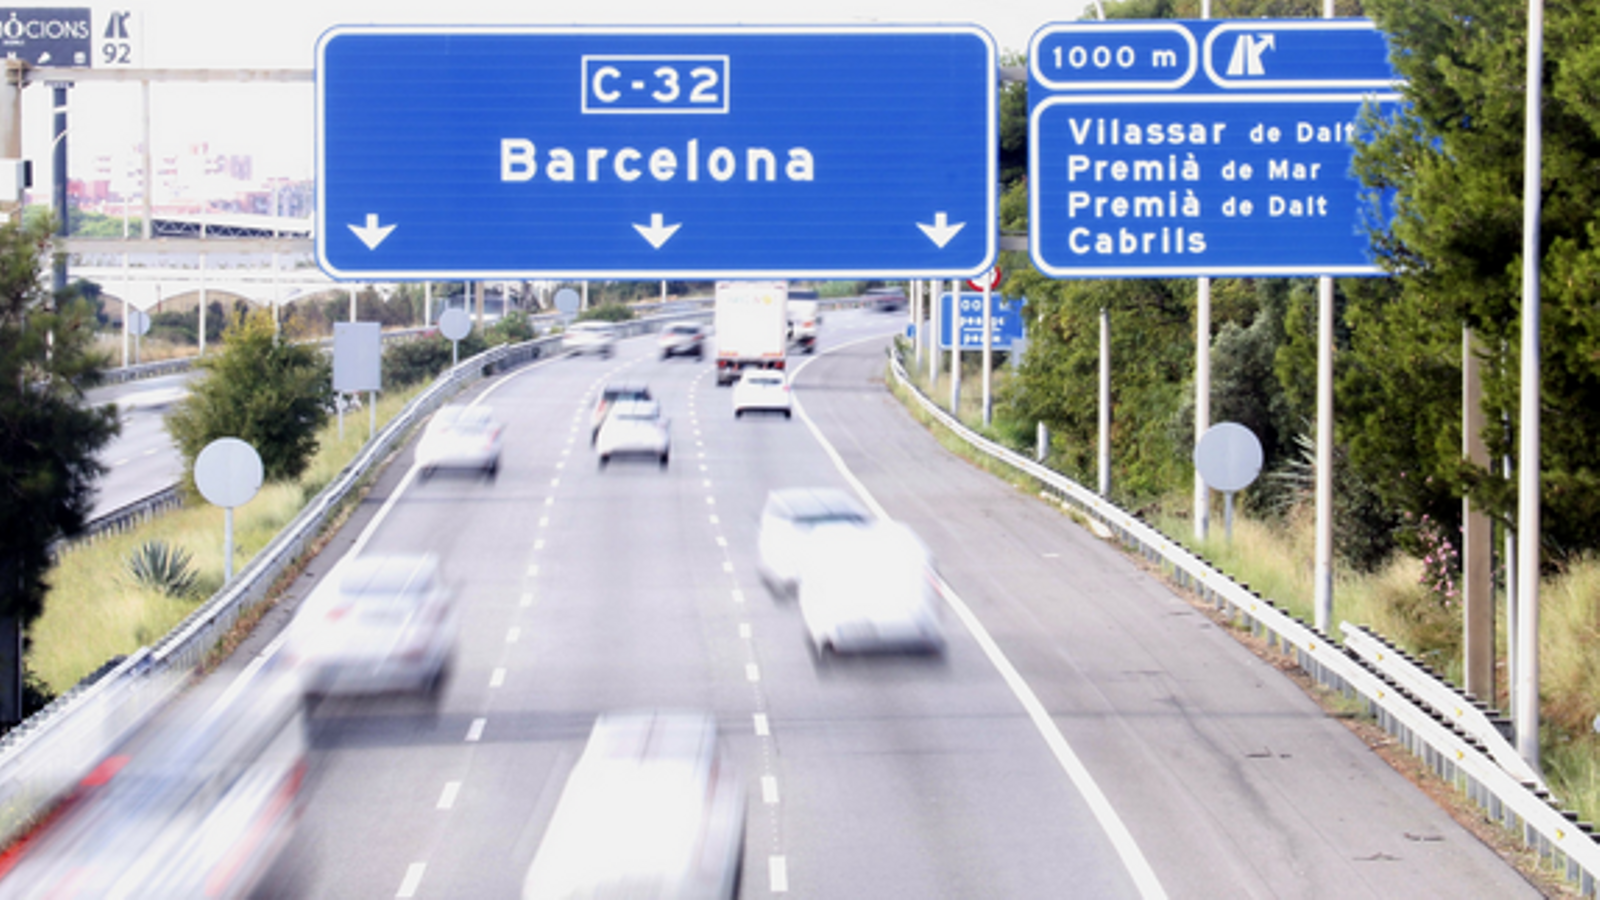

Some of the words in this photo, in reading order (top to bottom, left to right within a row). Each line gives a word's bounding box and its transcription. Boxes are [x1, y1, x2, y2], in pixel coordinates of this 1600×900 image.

[102, 43, 131, 64] 92
[1053, 46, 1135, 68] 1000
[1152, 49, 1177, 67] m
[592, 66, 719, 103] C-32
[1068, 118, 1226, 145] Vilassar
[1249, 123, 1281, 143] de
[1297, 122, 1355, 143] Dalt
[500, 138, 814, 182] Barcelona
[1068, 153, 1200, 182] Premià
[1221, 160, 1253, 180] de
[1268, 159, 1321, 180] Mar
[1068, 189, 1200, 218] Premià
[1221, 196, 1254, 217] de
[1269, 195, 1327, 217] Dalt
[1068, 227, 1207, 255] Cabrils
